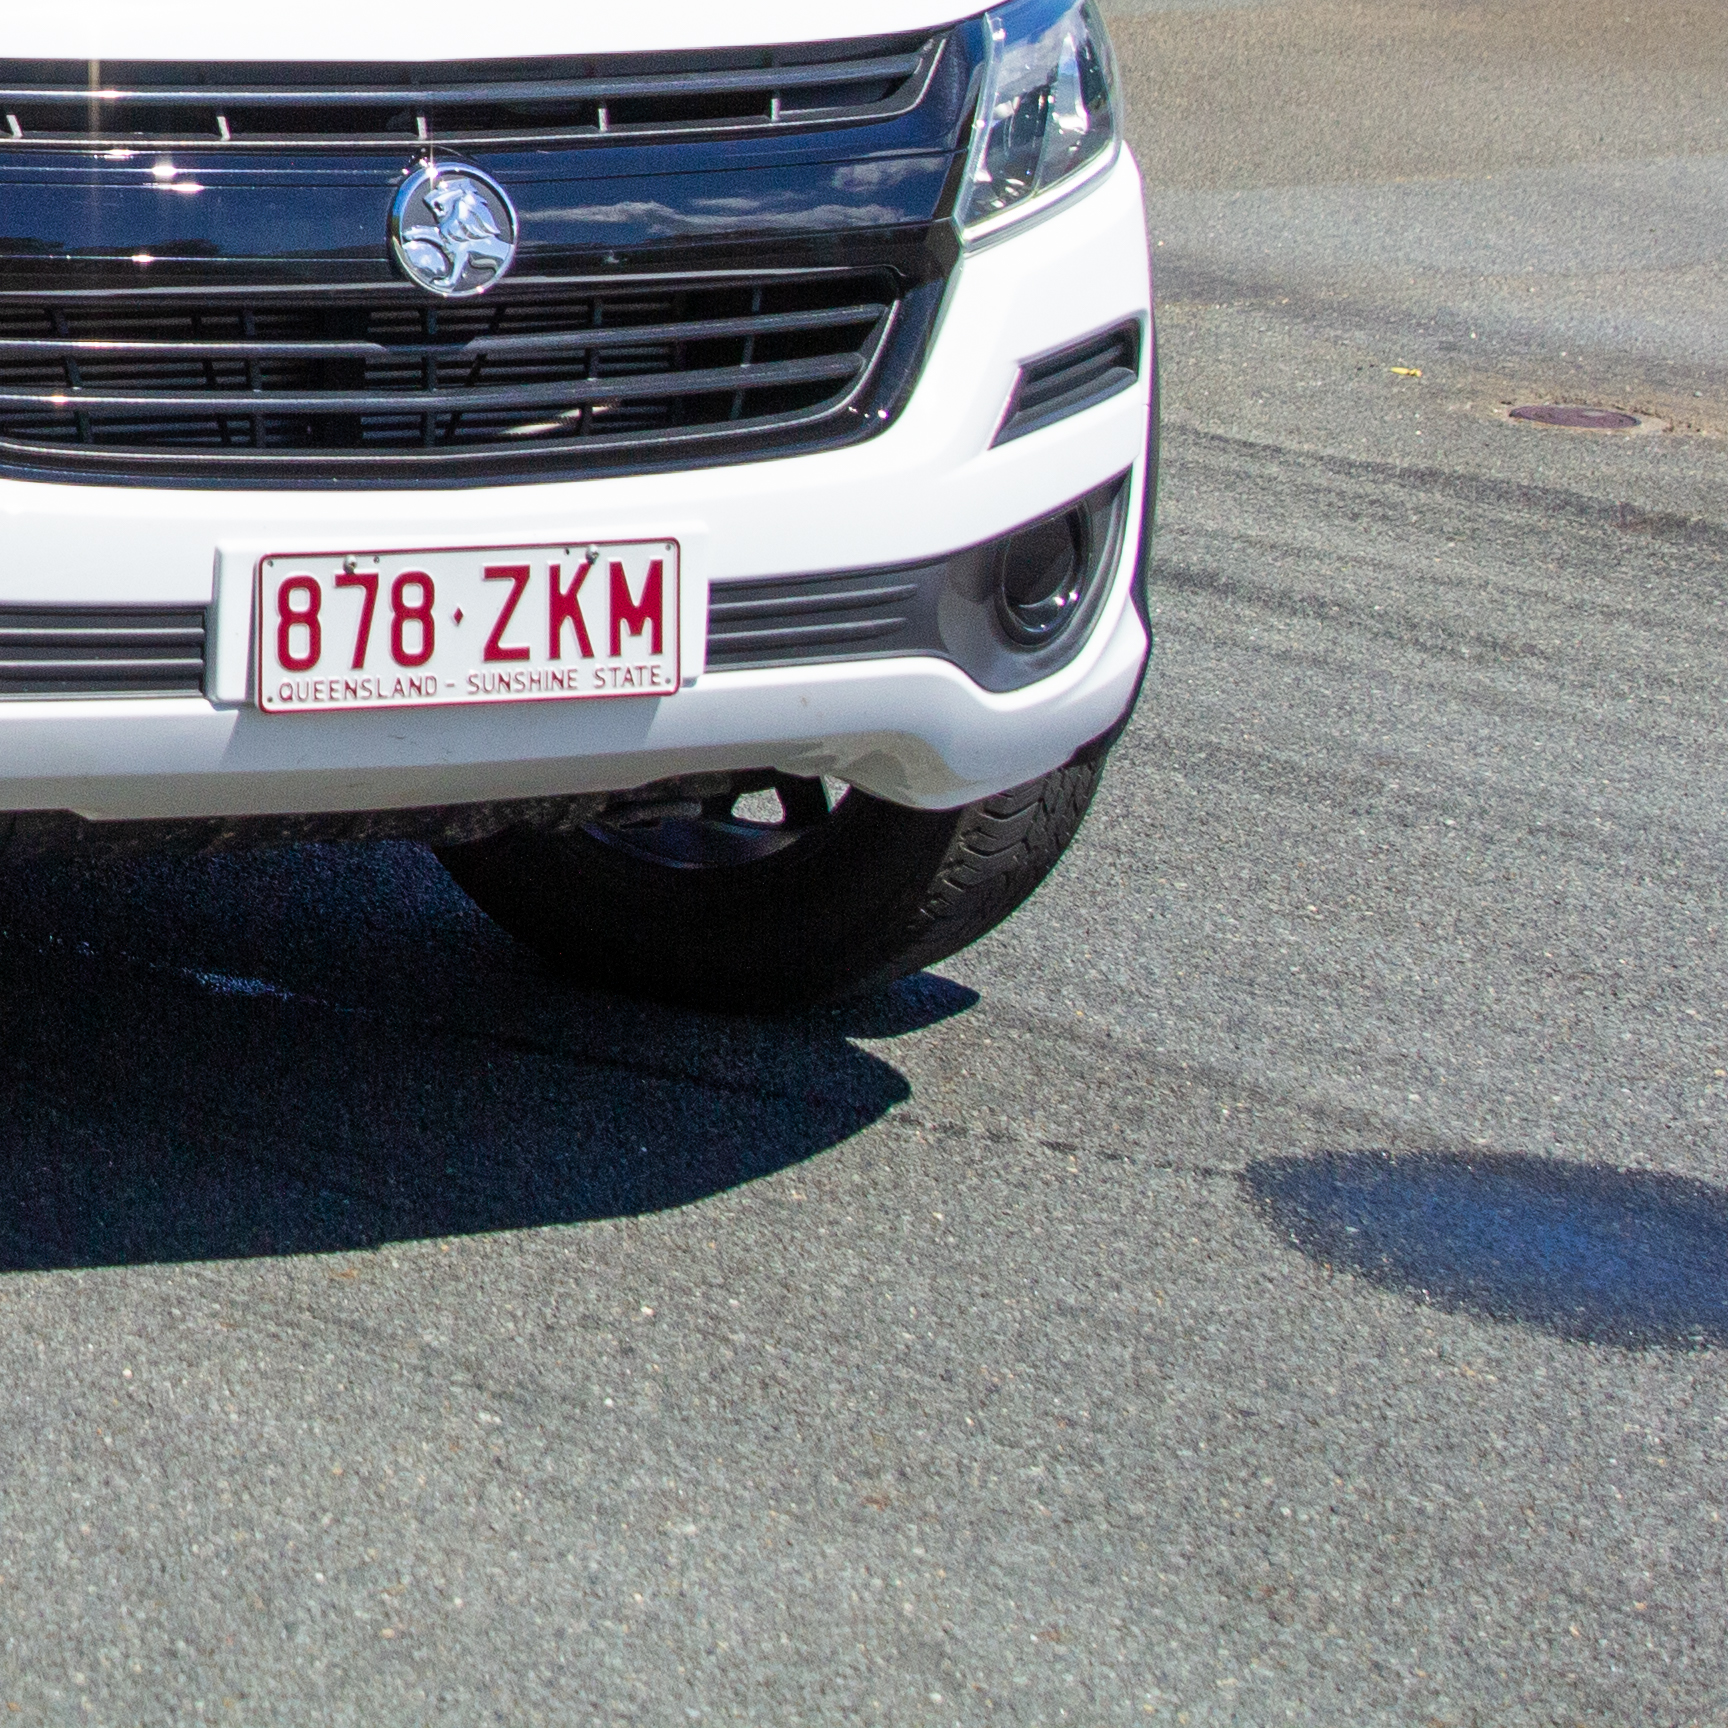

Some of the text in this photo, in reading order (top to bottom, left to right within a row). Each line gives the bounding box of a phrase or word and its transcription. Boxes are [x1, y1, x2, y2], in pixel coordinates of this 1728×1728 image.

[278, 675, 438, 702] QUEENSLAND
[466, 668, 579, 694] SUNSHINE
[593, 665, 661, 688] STATE
